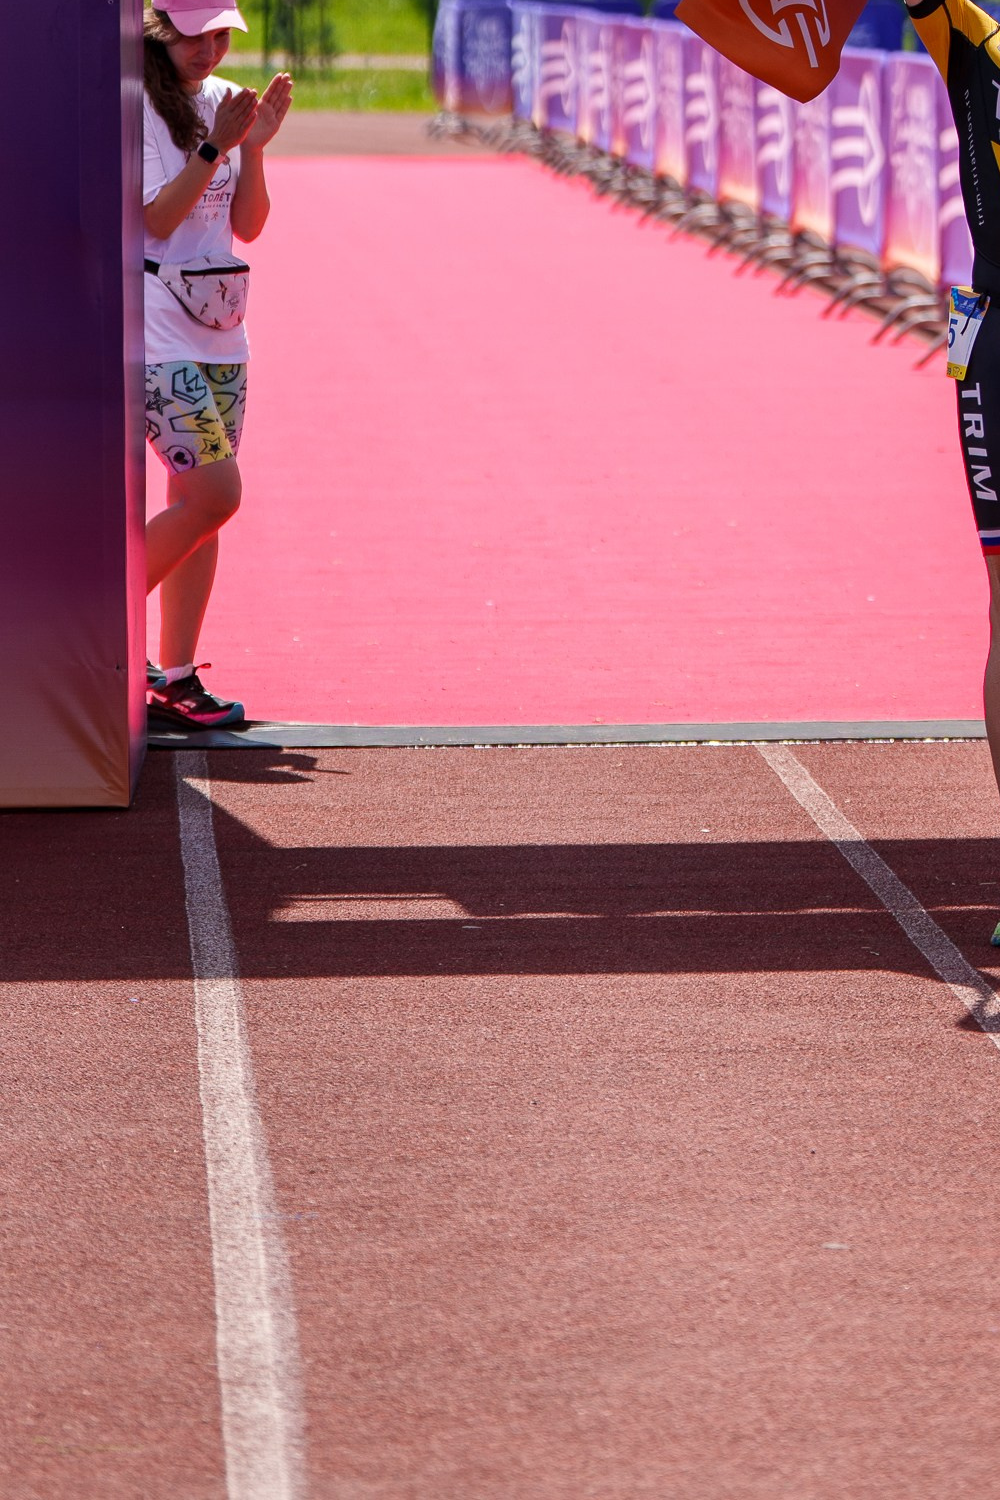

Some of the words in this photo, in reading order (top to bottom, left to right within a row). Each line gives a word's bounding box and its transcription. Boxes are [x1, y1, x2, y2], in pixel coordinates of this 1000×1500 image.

[964, 88, 985, 227] trim-triathlon.ru
[225, 419, 238, 448] LOVE
[961, 383, 997, 501] TRIM
